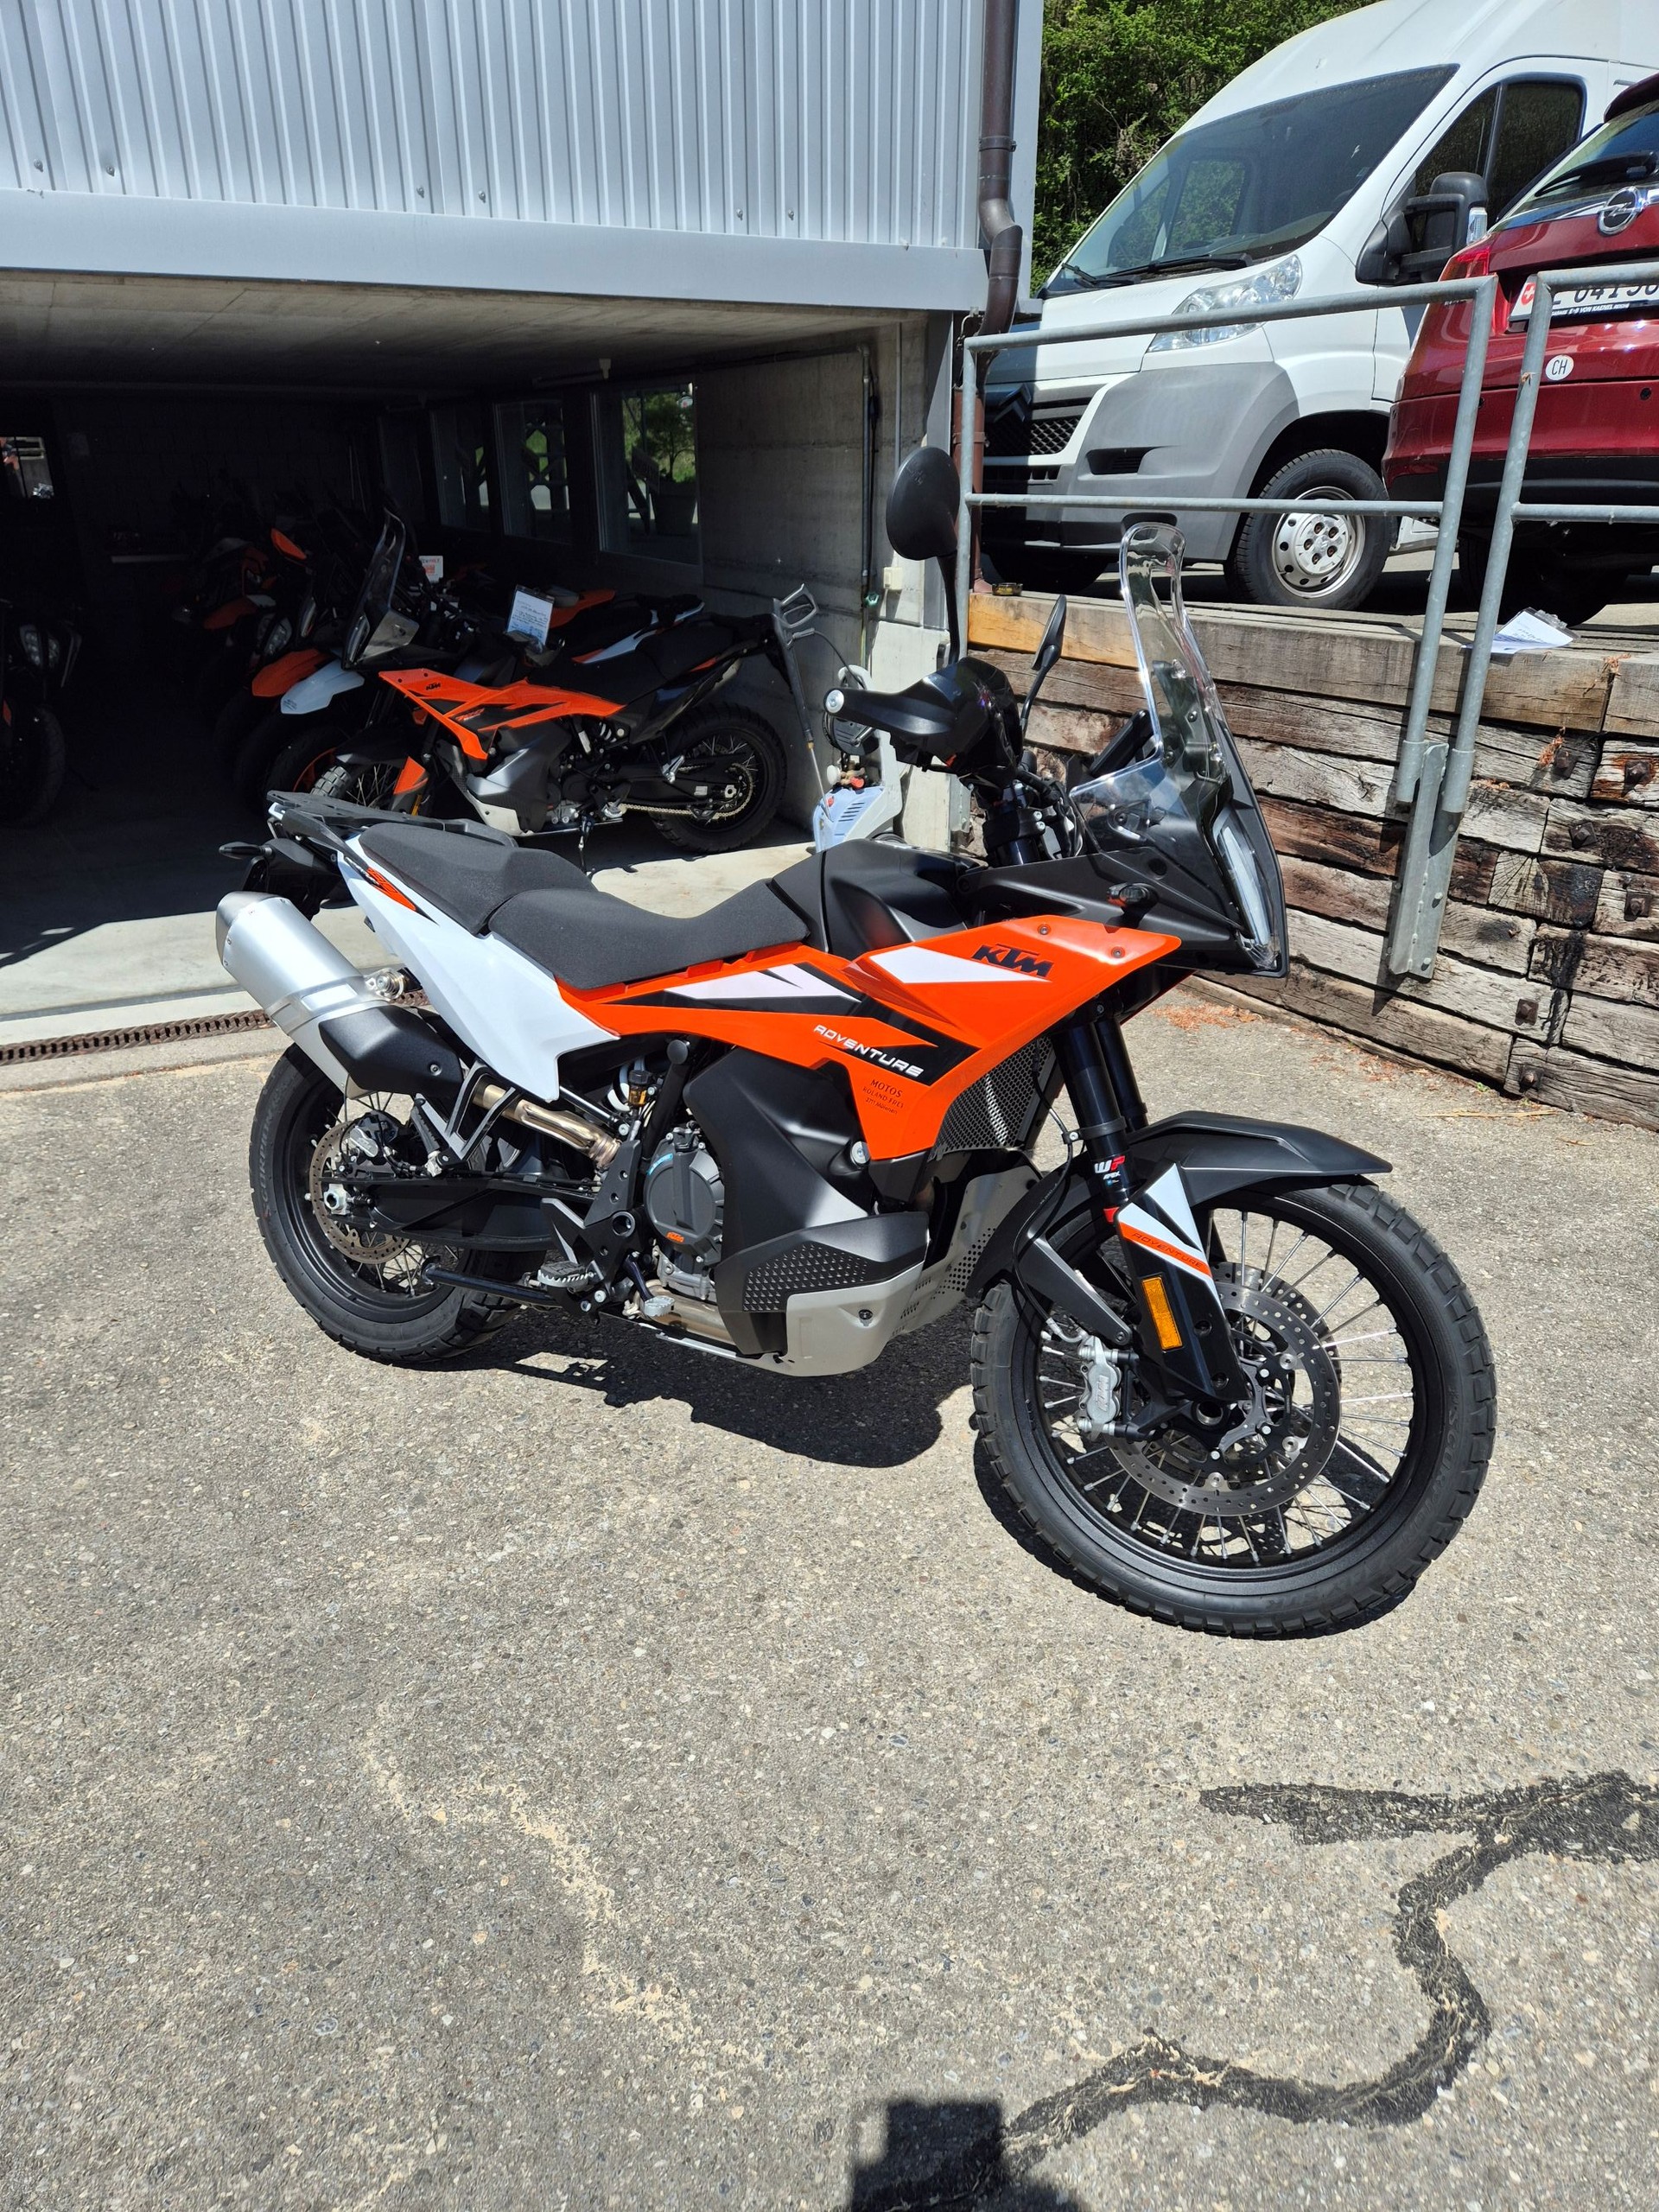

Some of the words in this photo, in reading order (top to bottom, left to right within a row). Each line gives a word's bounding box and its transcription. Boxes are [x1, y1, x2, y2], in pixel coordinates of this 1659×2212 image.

[1551, 359, 1567, 376] CH
[426, 682, 442, 691] KTM
[970, 943, 1054, 977] KTM
[813, 1024, 925, 1077] ADVENTURE
[862, 1086, 888, 1102] ROLAND
[870, 1079, 904, 1098] MOTOS
[1094, 1155, 1126, 1173] WP
[1132, 1232, 1202, 1268] ADVENTURE
